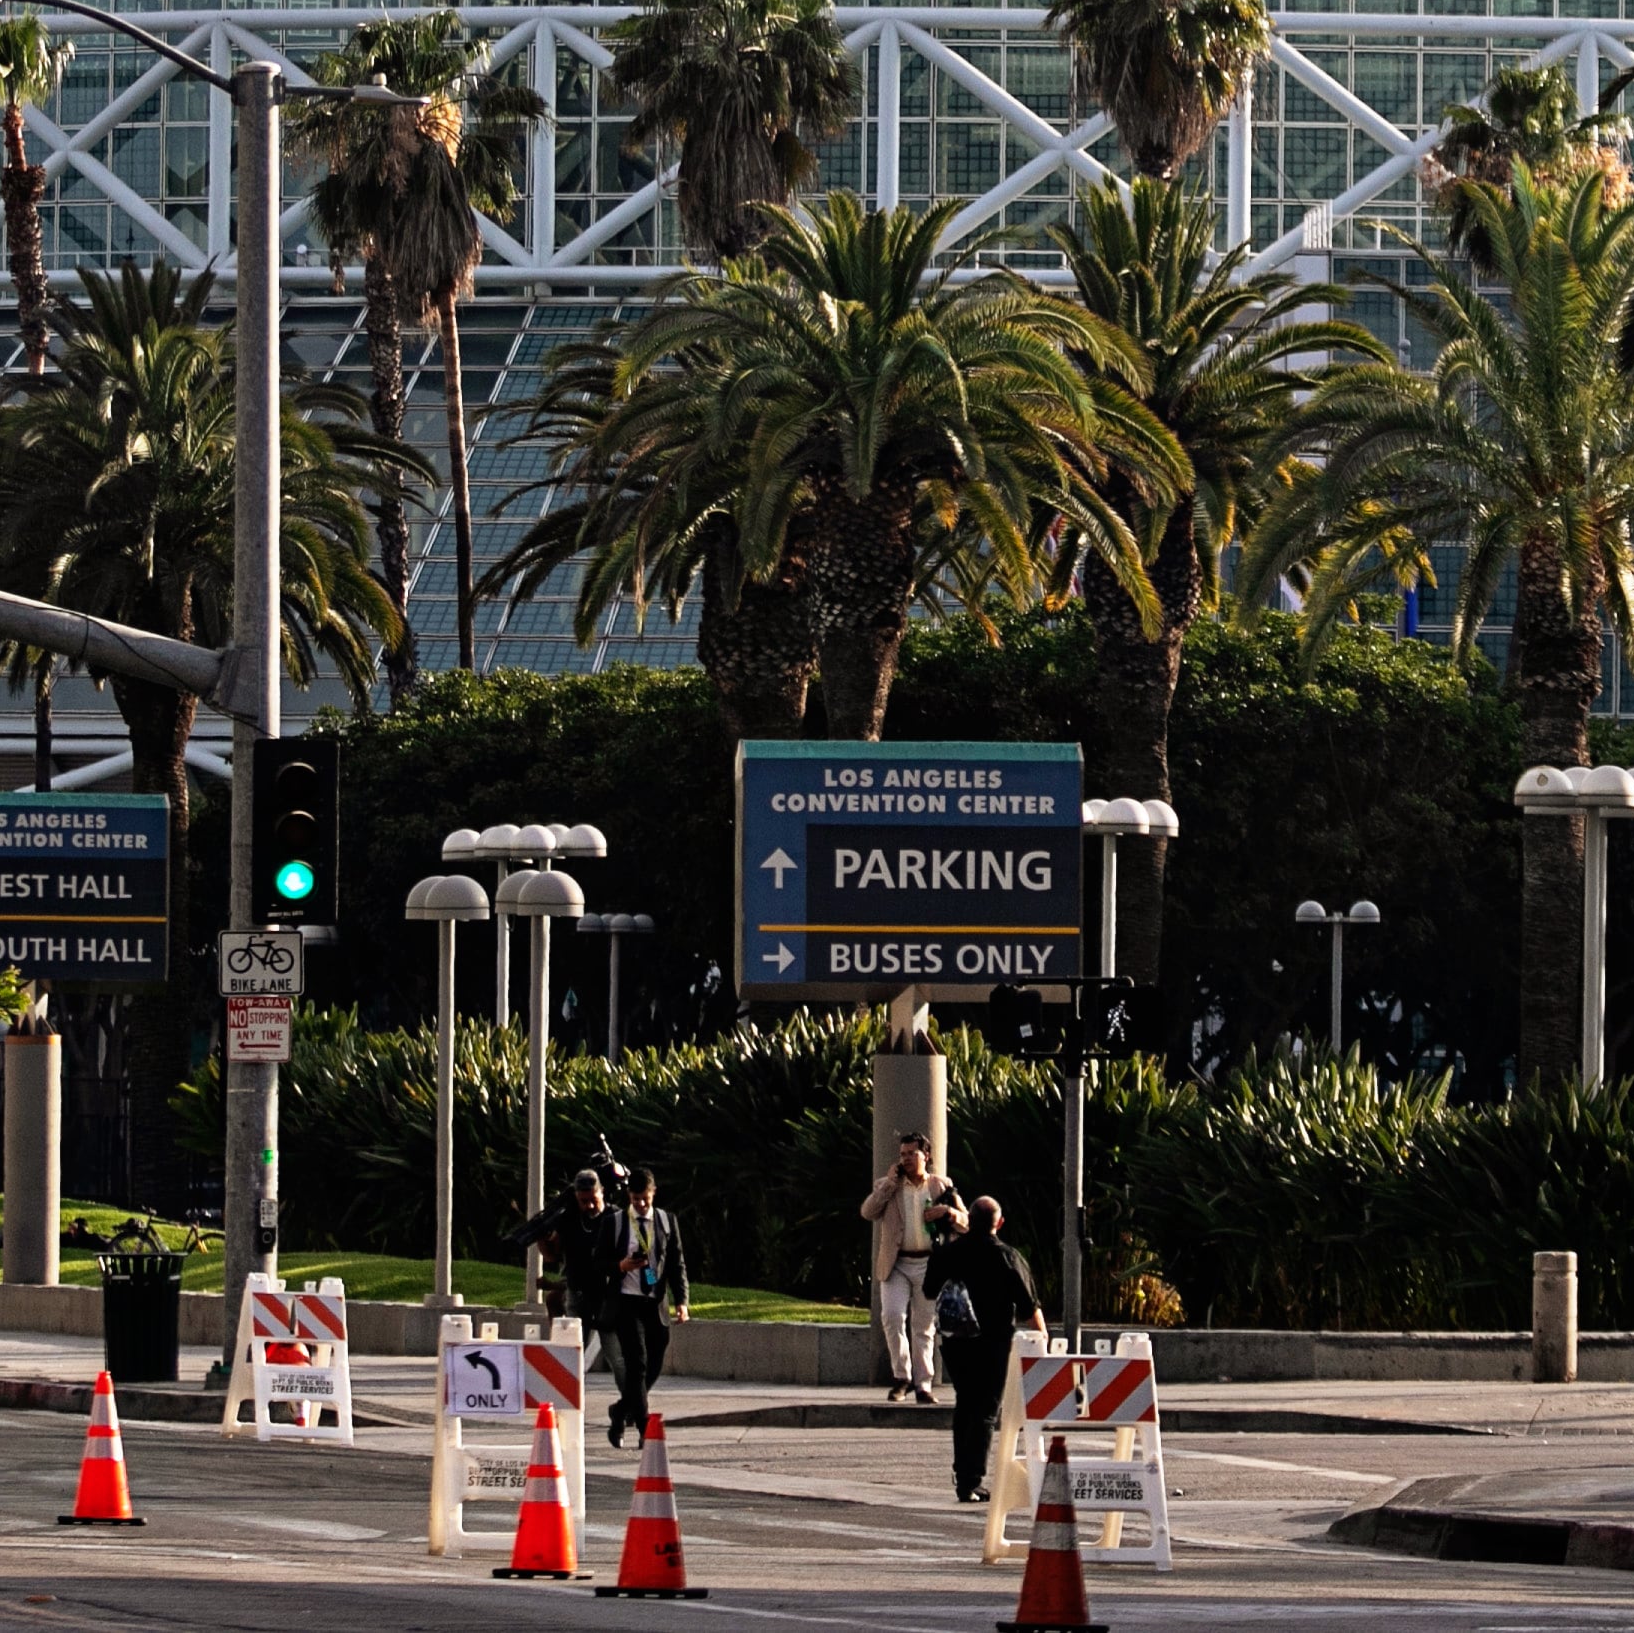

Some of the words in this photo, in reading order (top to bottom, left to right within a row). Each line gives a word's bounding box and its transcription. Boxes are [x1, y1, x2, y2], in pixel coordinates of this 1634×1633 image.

[824, 768, 874, 788] LOS
[884, 769, 1003, 789] ANGELES
[771, 793, 946, 813] CONVENTION
[958, 795, 1055, 815] CENTER
[15, 813, 106, 829] ANGELES
[72, 833, 148, 849] CENTER
[835, 848, 1053, 891] PARKING
[58, 875, 132, 899] HALL
[78, 937, 151, 963] HALL
[830, 944, 943, 975] BUSES
[956, 945, 1054, 975] ONLY
[231, 979, 256, 991] BIKE
[261, 979, 292, 991] LANE
[231, 998, 288, 1006] TOW-AWAY
[230, 1011, 246, 1026] NO
[249, 1012, 288, 1024] STOPPING
[237, 1031, 255, 1040] ANY
[262, 1031, 283, 1040] TIME
[272, 1385, 298, 1393] STREET
[300, 1386, 334, 1394] SERVICES
[466, 1394, 507, 1408] ONLY
[468, 1476, 507, 1486] STREET
[1089, 1480, 1114, 1488] PUBLIC
[1095, 1489, 1143, 1500] SERVICES
